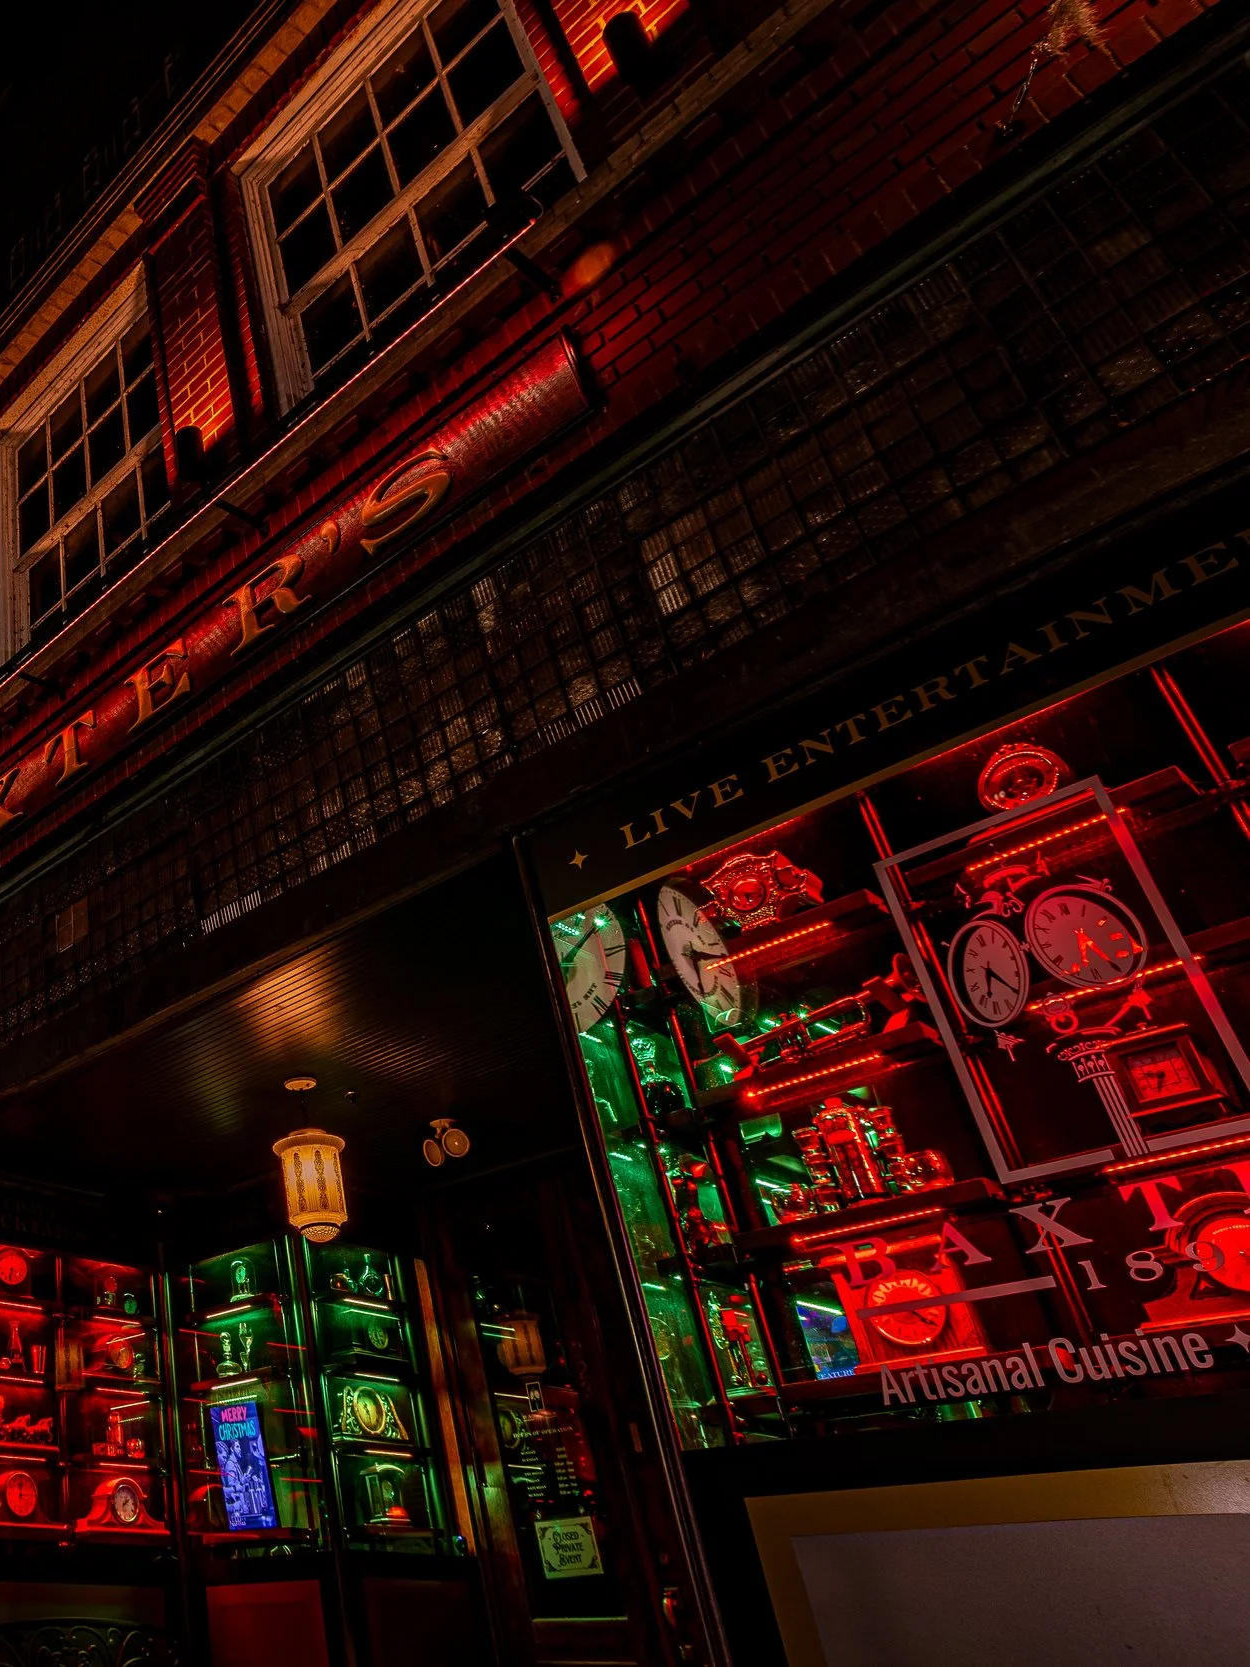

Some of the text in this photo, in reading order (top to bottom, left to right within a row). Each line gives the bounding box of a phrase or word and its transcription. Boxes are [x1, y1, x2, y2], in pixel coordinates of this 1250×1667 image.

[619, 528, 1250, 850] LIVE ENTERTAINME
[880, 1329, 1215, 1406] Artisanal Cuisine
[218, 1420, 256, 1441] CHRISTMAS
[221, 1406, 247, 1423] MERRY
